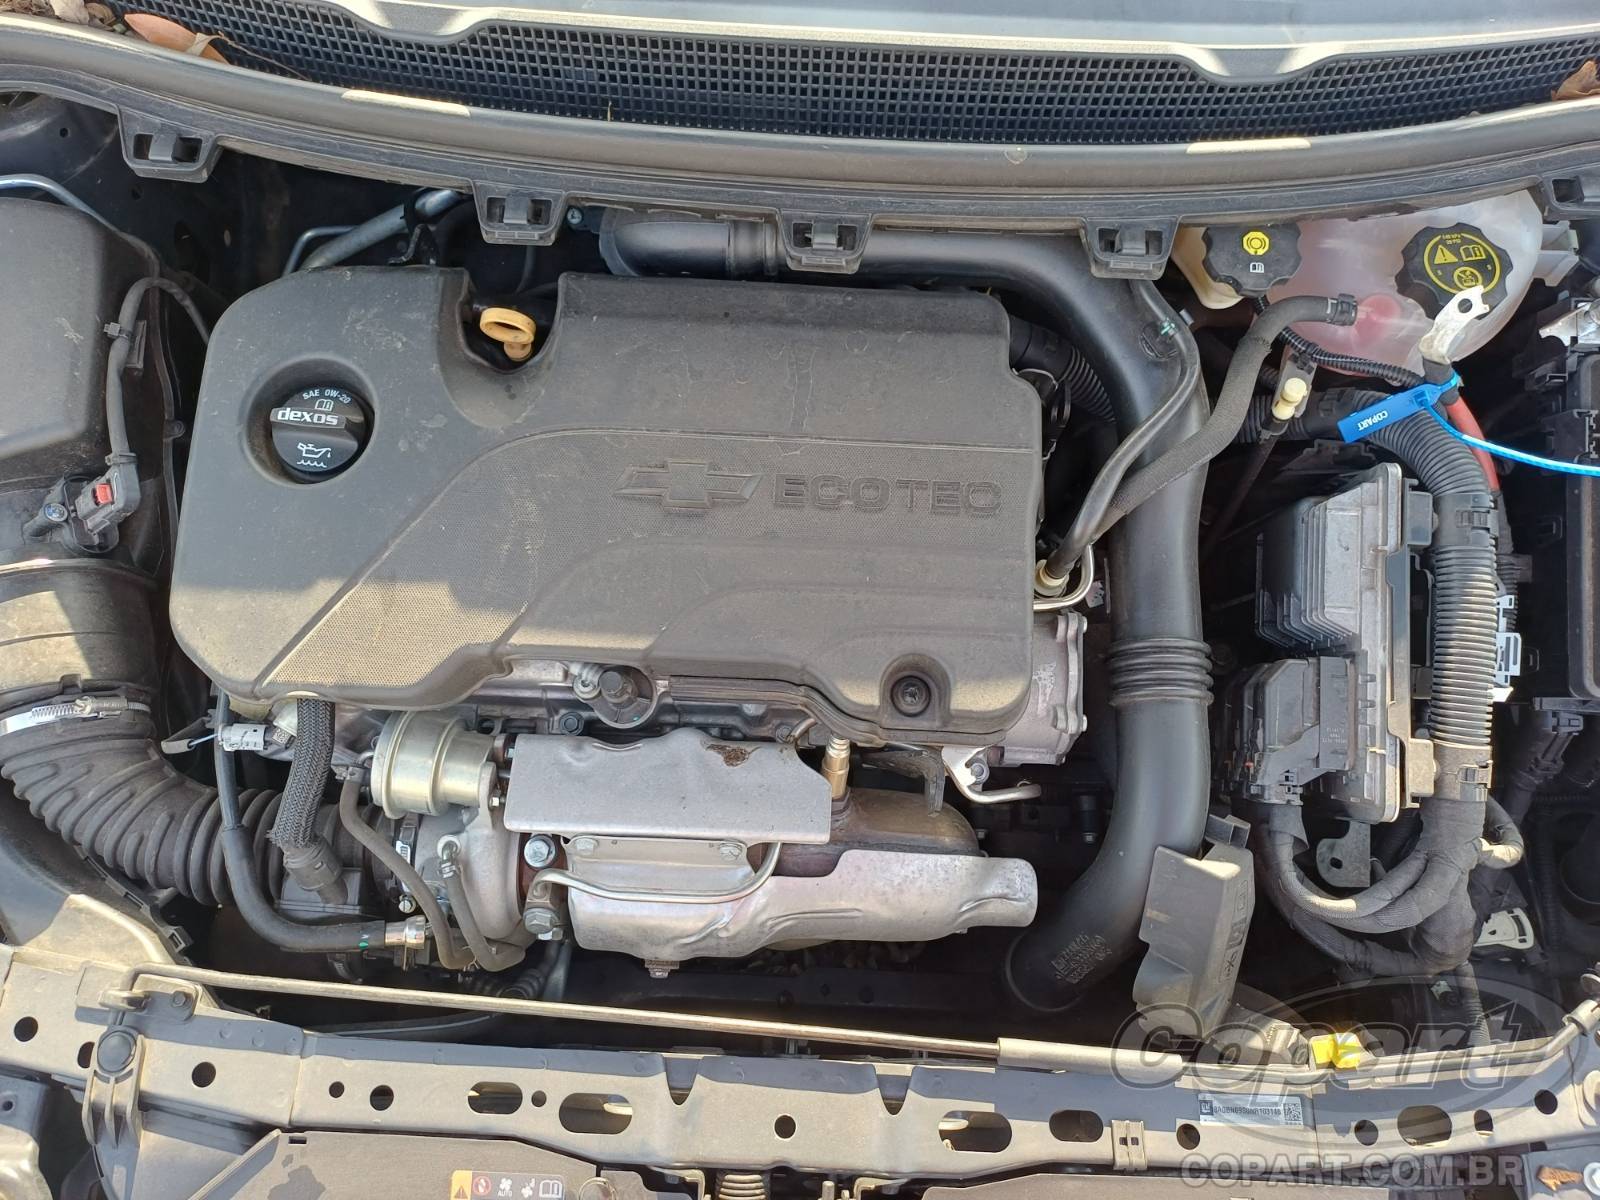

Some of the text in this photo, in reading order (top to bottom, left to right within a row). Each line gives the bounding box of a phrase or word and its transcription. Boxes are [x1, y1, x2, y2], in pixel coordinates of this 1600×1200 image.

[302, 388, 352, 404] SAE 0W-20
[277, 407, 339, 426] dexos
[1357, 410, 1389, 431] COPART
[773, 473, 1001, 516] ECOTEC
